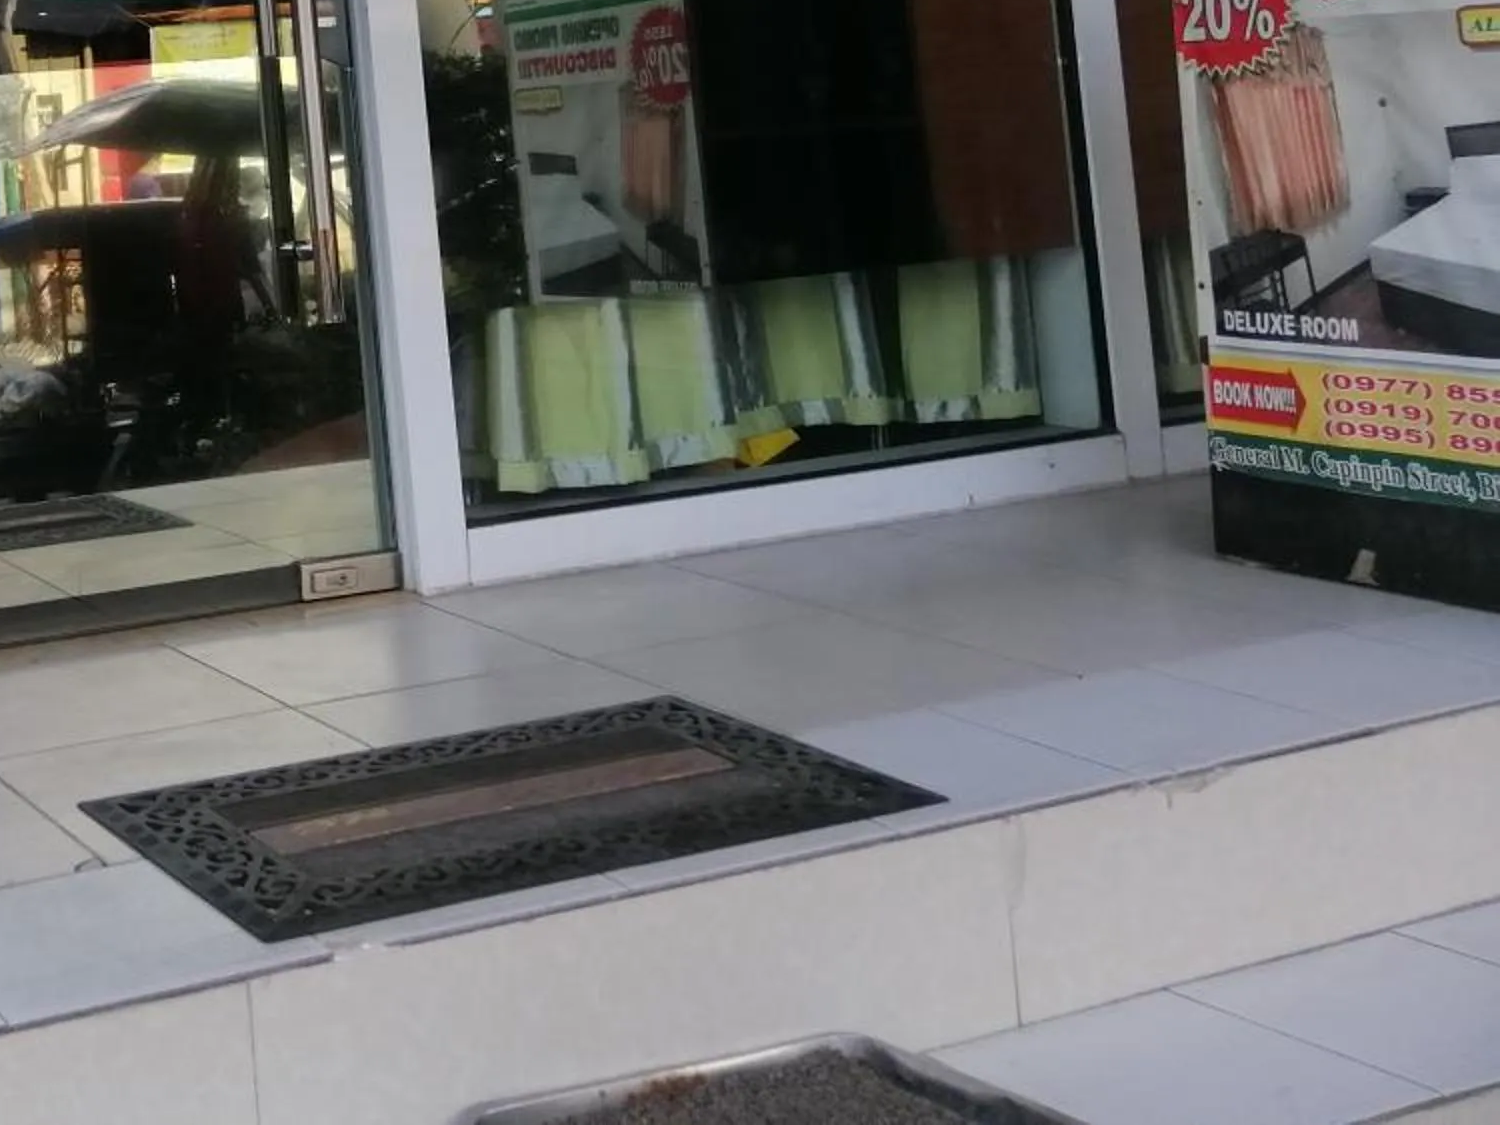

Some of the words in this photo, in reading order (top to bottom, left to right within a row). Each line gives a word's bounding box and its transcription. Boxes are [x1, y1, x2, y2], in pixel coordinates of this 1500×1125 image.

[1223, 310, 1296, 336] DELUXE
[1300, 314, 1359, 341] ROOM
[1214, 380, 1252, 407] BOOK
[1321, 373, 1433, 400] (0977)
[1323, 399, 1434, 426] (0919)
[1324, 422, 1436, 450] (0995)
[1209, 436, 1280, 472] General
[1283, 445, 1309, 474] M.
[1311, 450, 1404, 492] Capinpin
[1407, 462, 1477, 503] Street,
